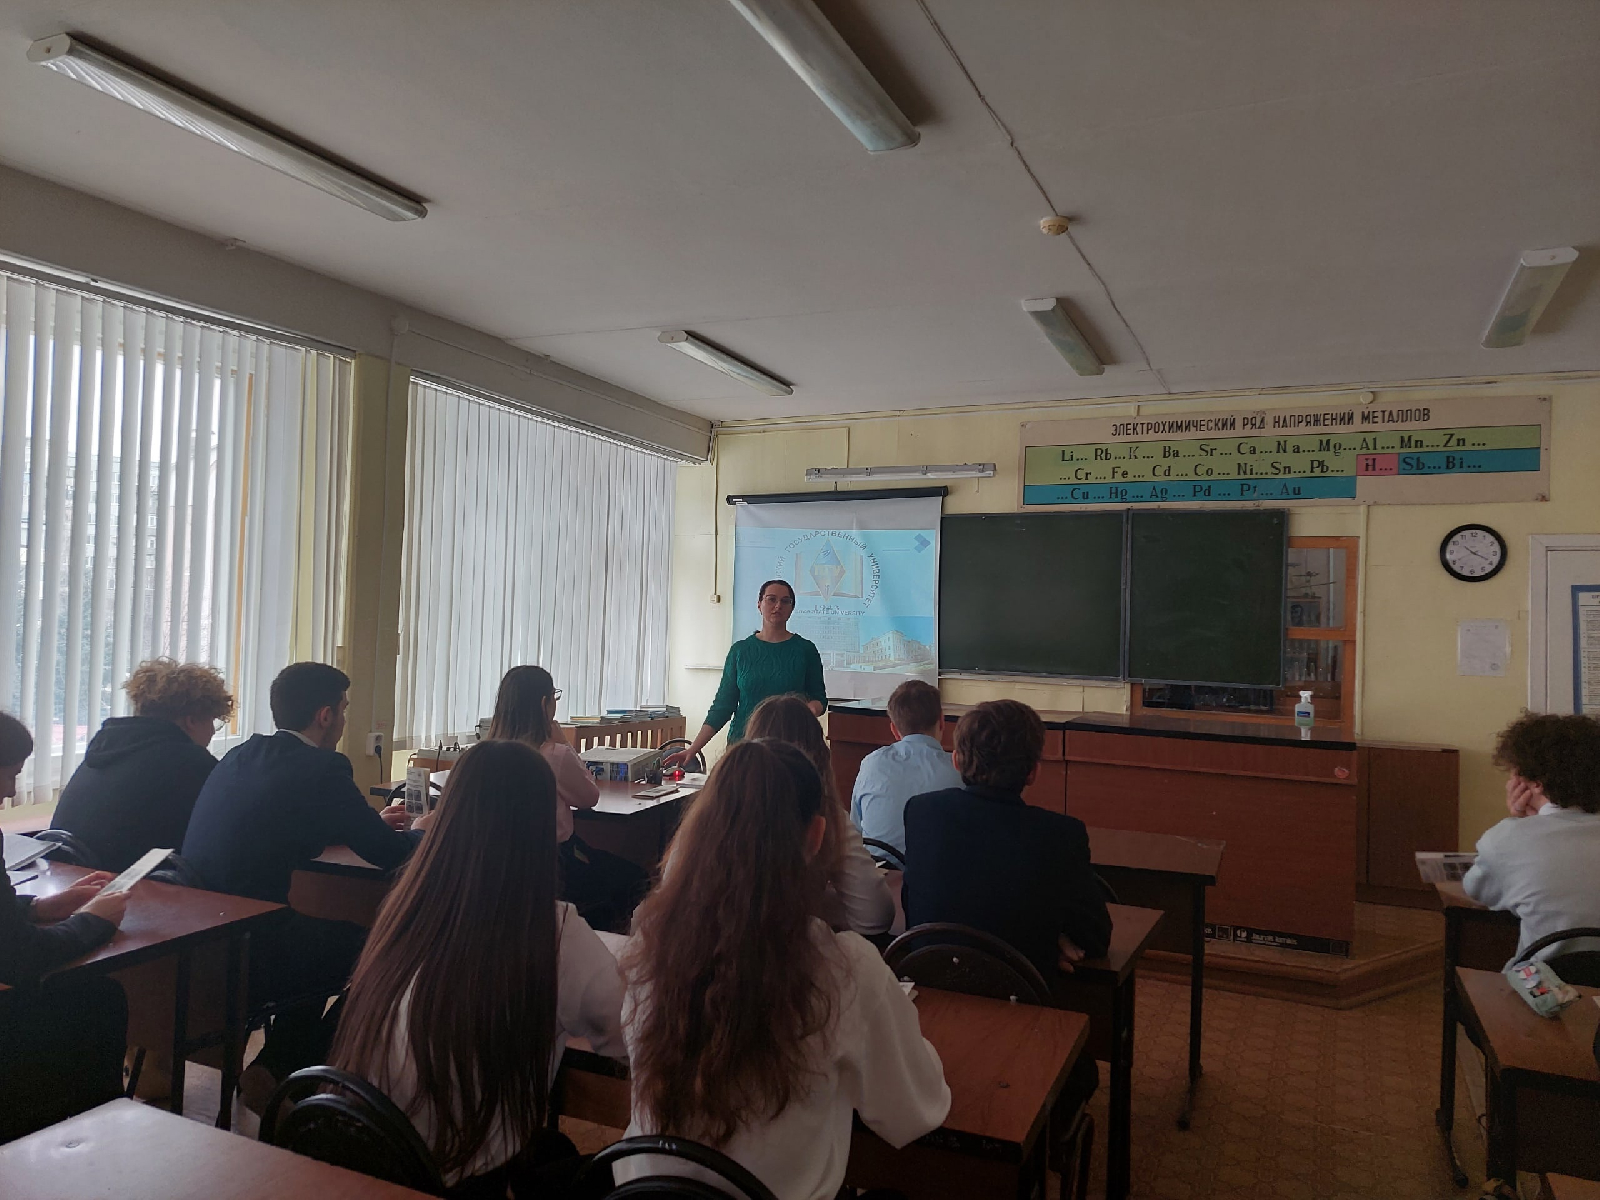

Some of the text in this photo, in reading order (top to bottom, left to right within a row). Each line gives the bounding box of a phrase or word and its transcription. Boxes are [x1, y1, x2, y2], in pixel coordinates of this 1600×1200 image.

[1111, 408, 1431, 437] ЭЛЕКТРОХИМИЧЕСКИЙ РЯД НАПРЯЖЕНИЙ МЕТАЛЛОВ
[1280, 482, 1302, 496] Au
[785, 530, 881, 609] ГОСУДАРСТВЕННЫЙ УНИВЕРСИТЕТ
